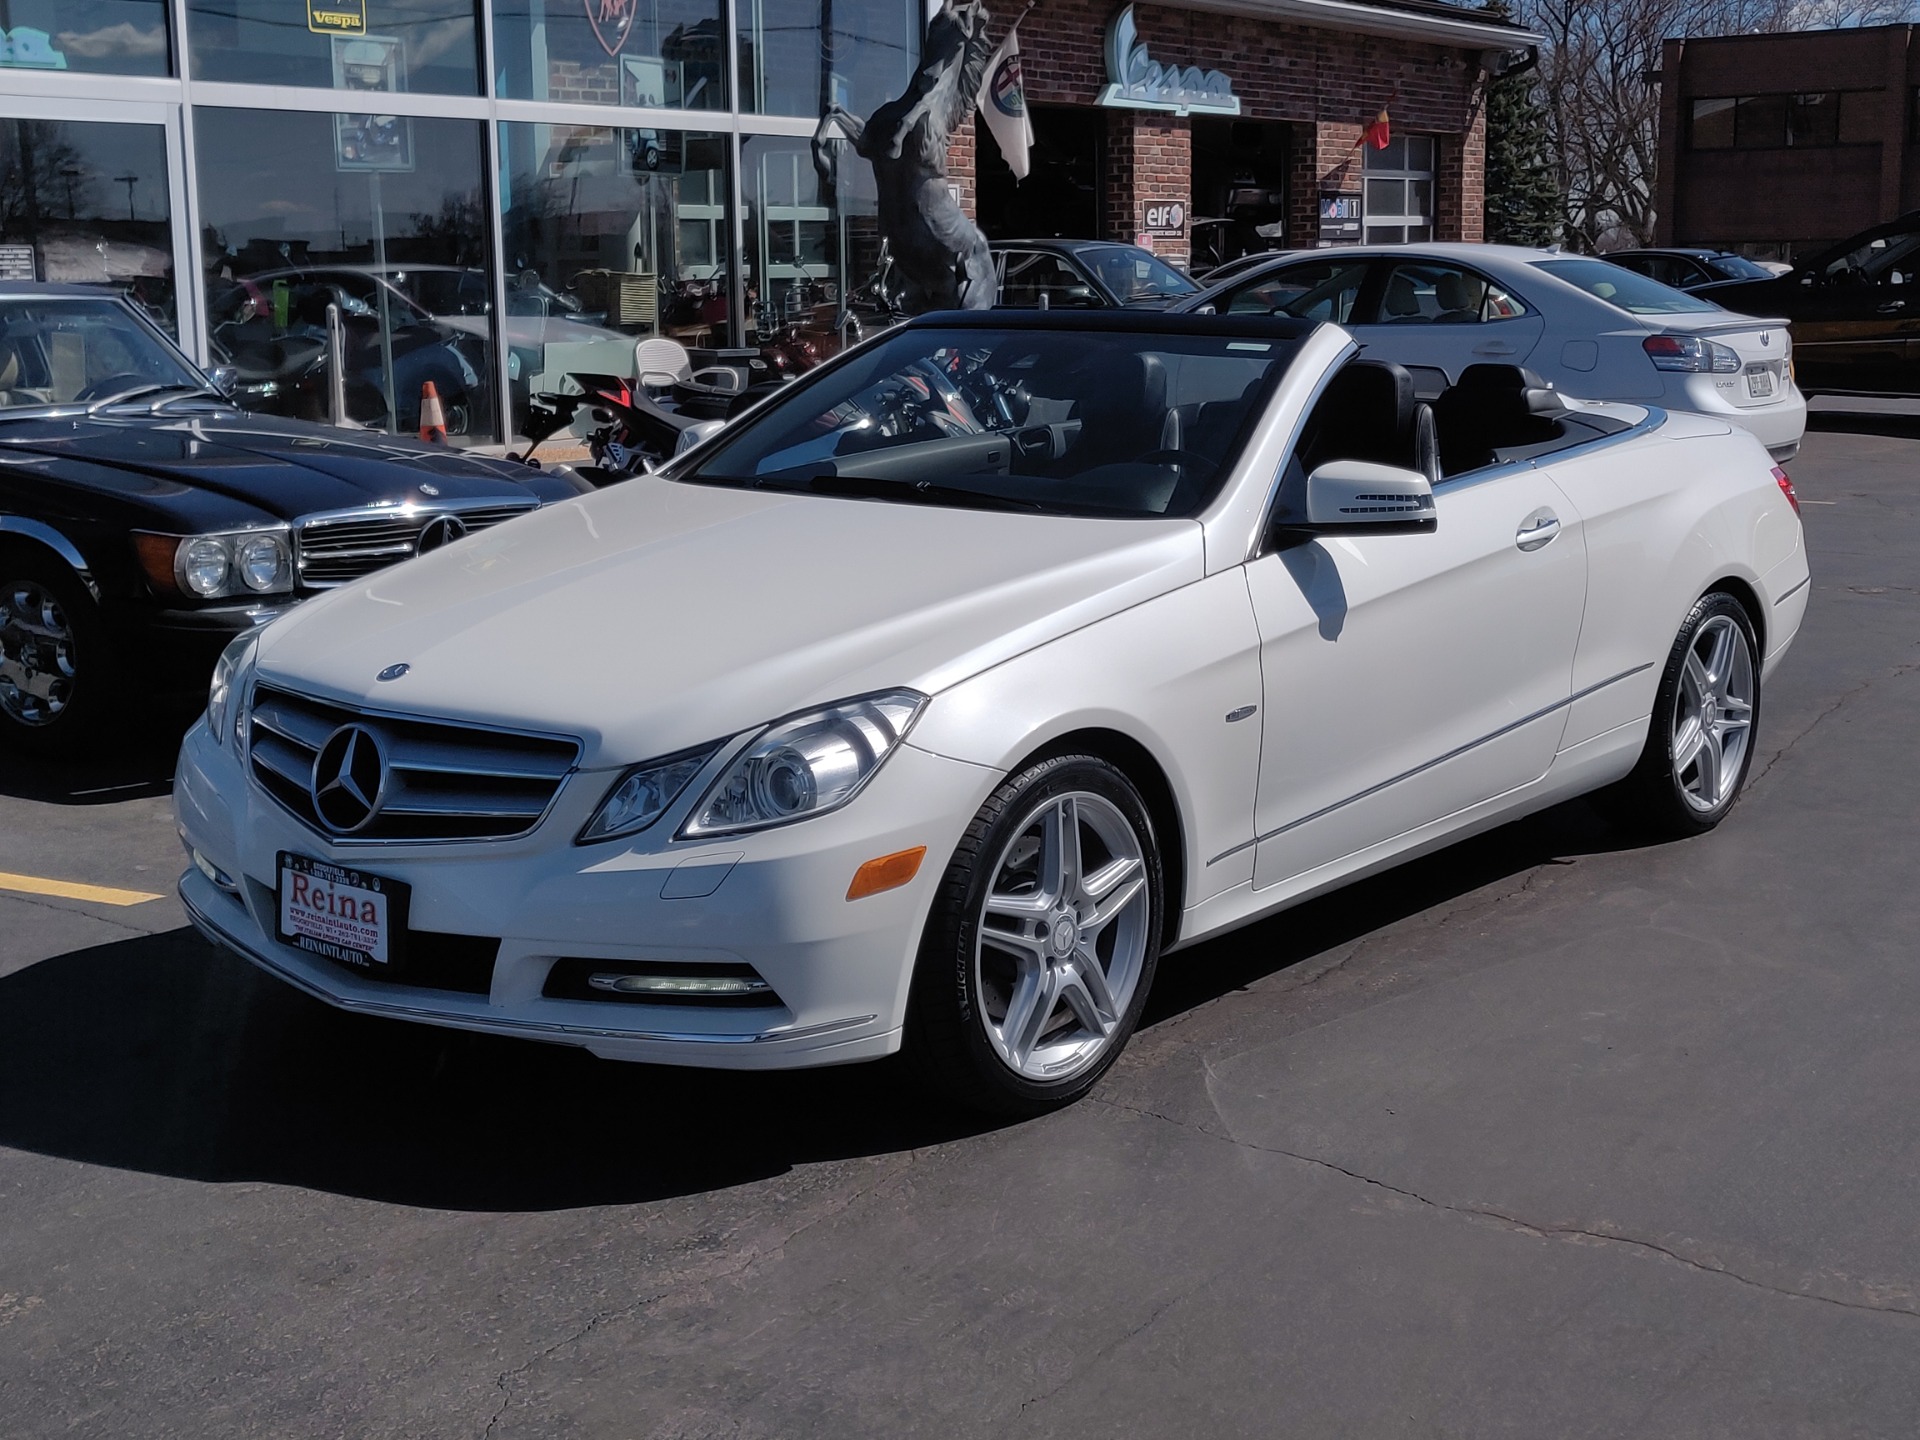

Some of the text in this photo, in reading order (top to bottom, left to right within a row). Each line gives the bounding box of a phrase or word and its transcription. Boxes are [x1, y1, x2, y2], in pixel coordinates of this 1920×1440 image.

[313, 10, 361, 28] Vespa
[1147, 206, 1170, 226] elf
[1320, 198, 1349, 218] Mobil
[291, 872, 378, 926] Reina
[290, 907, 379, 938] www.reinaintlauto.com
